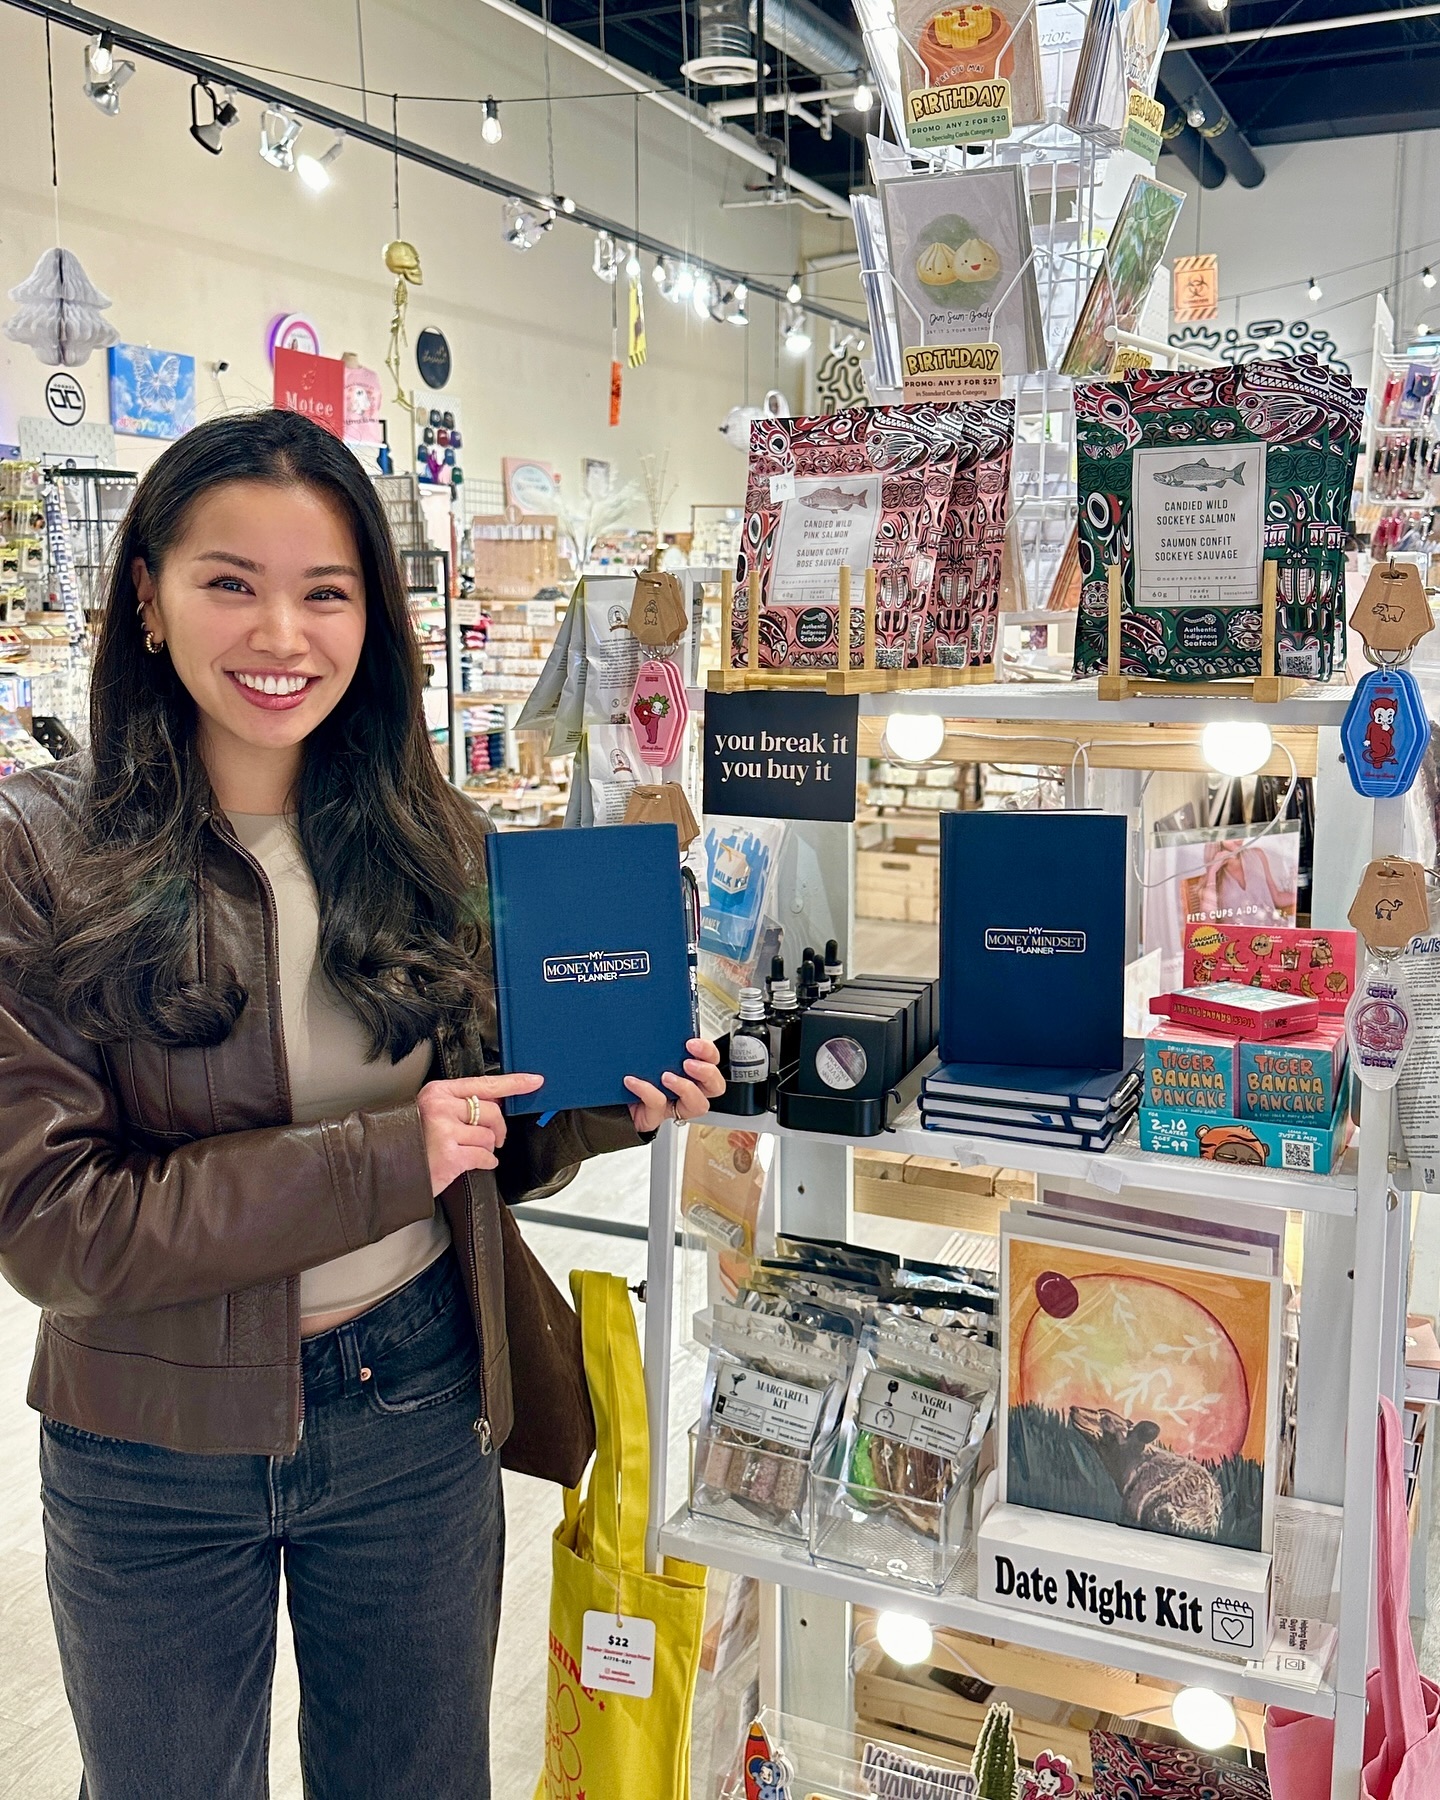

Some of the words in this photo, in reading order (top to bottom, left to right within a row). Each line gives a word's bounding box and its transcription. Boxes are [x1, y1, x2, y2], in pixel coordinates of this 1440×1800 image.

[968, 65, 984, 73] MAI
[911, 85, 1006, 121] BIRTHDAY
[946, 121, 962, 129] ANY
[972, 117, 988, 125] FOR
[991, 115, 1006, 123] $20
[932, 133, 955, 142] Specialty
[970, 128, 994, 137] Category
[930, 313, 945, 326] Dim
[947, 307, 993, 324] Sum-Body
[906, 348, 999, 376] BIRTHDAY
[285, 390, 334, 418] Motee
[1164, 500, 1203, 511] CANDIED
[1206, 499, 1228, 509] WILD
[804, 519, 833, 528] CANDIED
[835, 519, 852, 528] WILD
[1156, 515, 1196, 525] SOCKEYE
[1199, 513, 1236, 524] SALMON
[821, 530, 848, 539] SALMON
[1160, 538, 1197, 548] SAUMON
[1200, 536, 1232, 546] CONFIT
[796, 549, 824, 557] SAUMON
[825, 548, 849, 556] CONFIT
[1155, 551, 1195, 561] SOCKEYE
[1197, 549, 1238, 560] SAUVAGE
[796, 560, 813, 568] ROSE
[815, 558, 845, 567] SAUVAGE
[1152, 591, 1168, 599] 60g
[714, 734, 754, 756] you
[760, 731, 826, 753] break
[832, 733, 849, 754] it
[721, 761, 761, 783] you
[767, 758, 809, 786] buy
[815, 760, 832, 781] it
[714, 868, 732, 888] MILK
[1186, 912, 1207, 922] FITS
[1209, 908, 1233, 919] CUPS
[1029, 927, 1043, 935] MY
[988, 934, 1029, 946] MONEY
[1031, 936, 1083, 948] MINDSET
[589, 951, 604, 960] MY
[1016, 947, 1054, 955] PLANNER
[547, 962, 590, 976] MONEY
[593, 958, 647, 972] MINDSET
[577, 972, 618, 982] PLANNER
[1202, 1007, 1232, 1024] BANANA
[1232, 1016, 1256, 1029] TIGER
[1158, 1052, 1215, 1071] TIGER
[1254, 1055, 1313, 1076] TIGER
[1151, 1068, 1225, 1091] BANANA
[1247, 1073, 1323, 1094] BANANA
[1151, 1088, 1227, 1109] PANCAKE
[1246, 1092, 1325, 1113] PANCAKE
[1150, 1119, 1187, 1130] 2-10
[1151, 1140, 1188, 1152] 7-99
[756, 1380, 809, 1405] MARGARITA
[773, 1397, 788, 1410] KIT
[911, 1390, 952, 1413] SANGRIA
[921, 1406, 938, 1419] KIT
[995, 1555, 1058, 1605] Date
[1065, 1569, 1147, 1625] Night
[1155, 1586, 1203, 1634] Kit
[1279, 1617, 1287, 1629] First
[1288, 1618, 1298, 1631] Guys
[1298, 1619, 1309, 1638] Helping
[608, 1635, 629, 1647] $22
[1289, 1632, 1297, 1647] Finish
[1299, 1639, 1308, 1650] Nice
